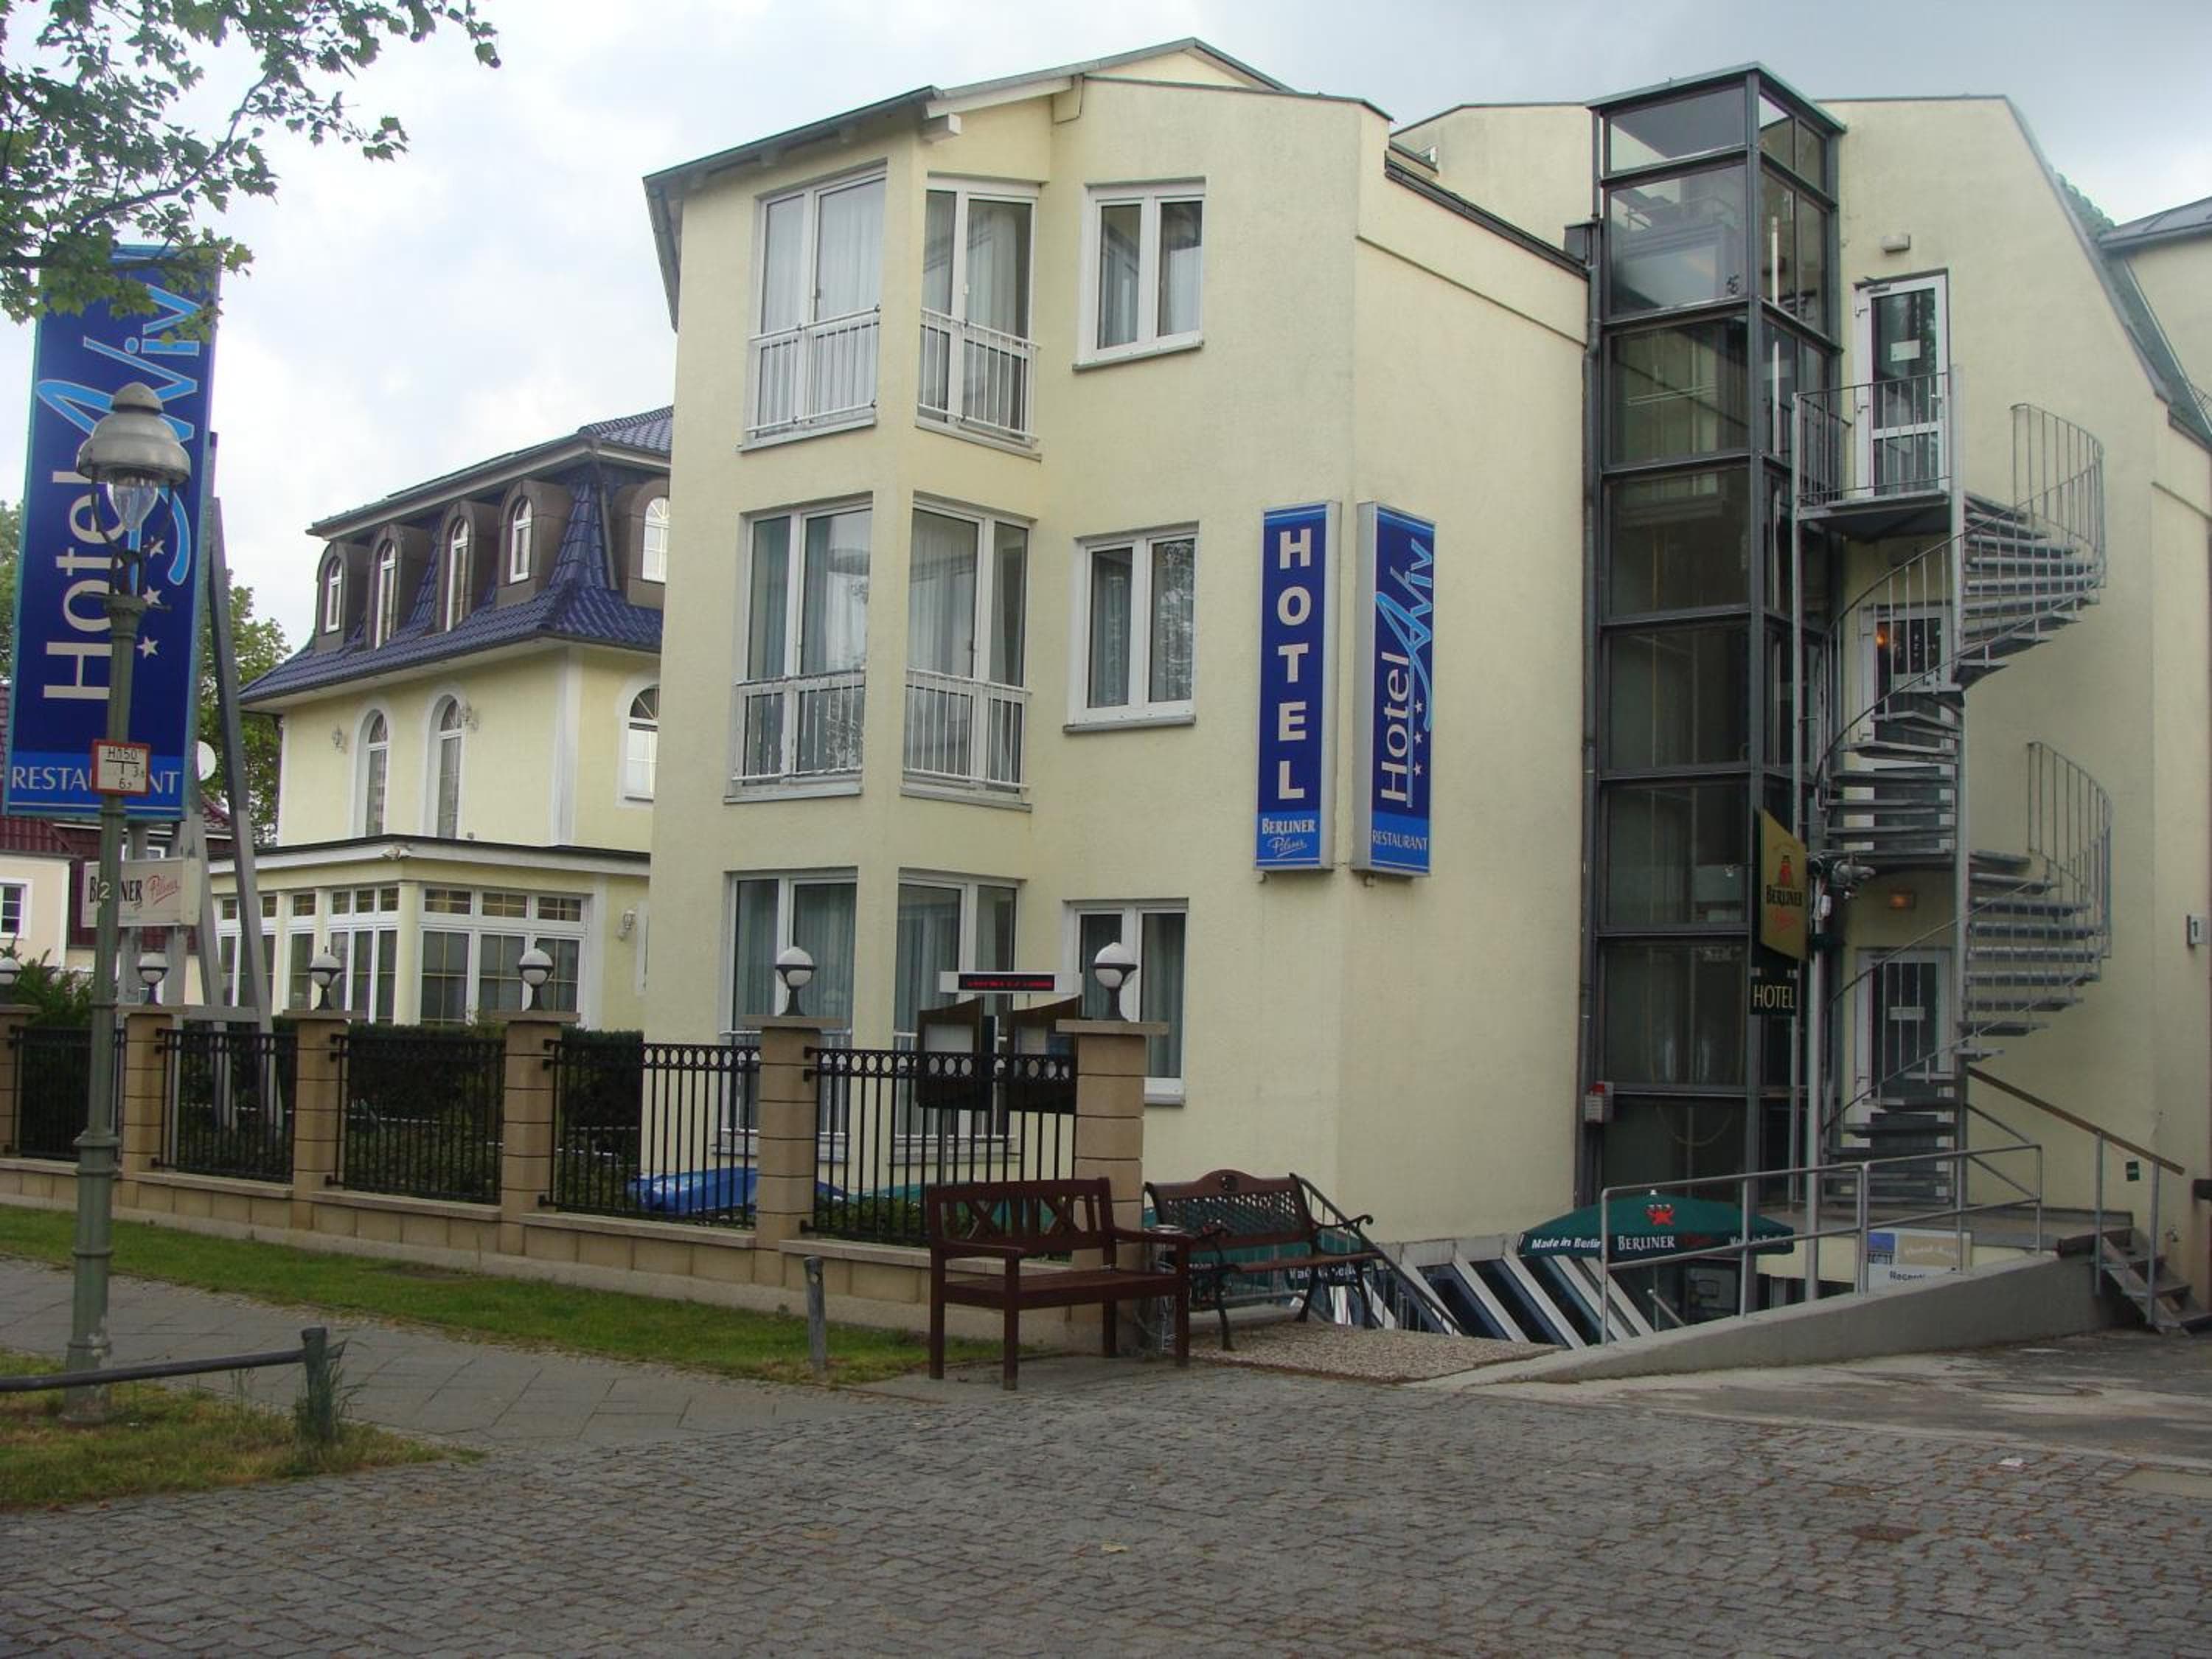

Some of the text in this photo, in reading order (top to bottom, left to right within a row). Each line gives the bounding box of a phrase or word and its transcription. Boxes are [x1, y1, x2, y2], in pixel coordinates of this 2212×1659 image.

[1277, 528, 1312, 800] HOTEL
[1380, 652, 1410, 802] Hotel
[11, 765, 181, 794] RESTANT
[1262, 818, 1316, 835] BERLINER
[1371, 829, 1427, 850] RESTAURANT
[89, 876, 142, 902] BNER
[1753, 985, 1795, 1009] HOTEL
[1531, 1238, 1559, 1249] Made
[1559, 1237, 1571, 1247] in
[1618, 1235, 1675, 1251] BERLINER
